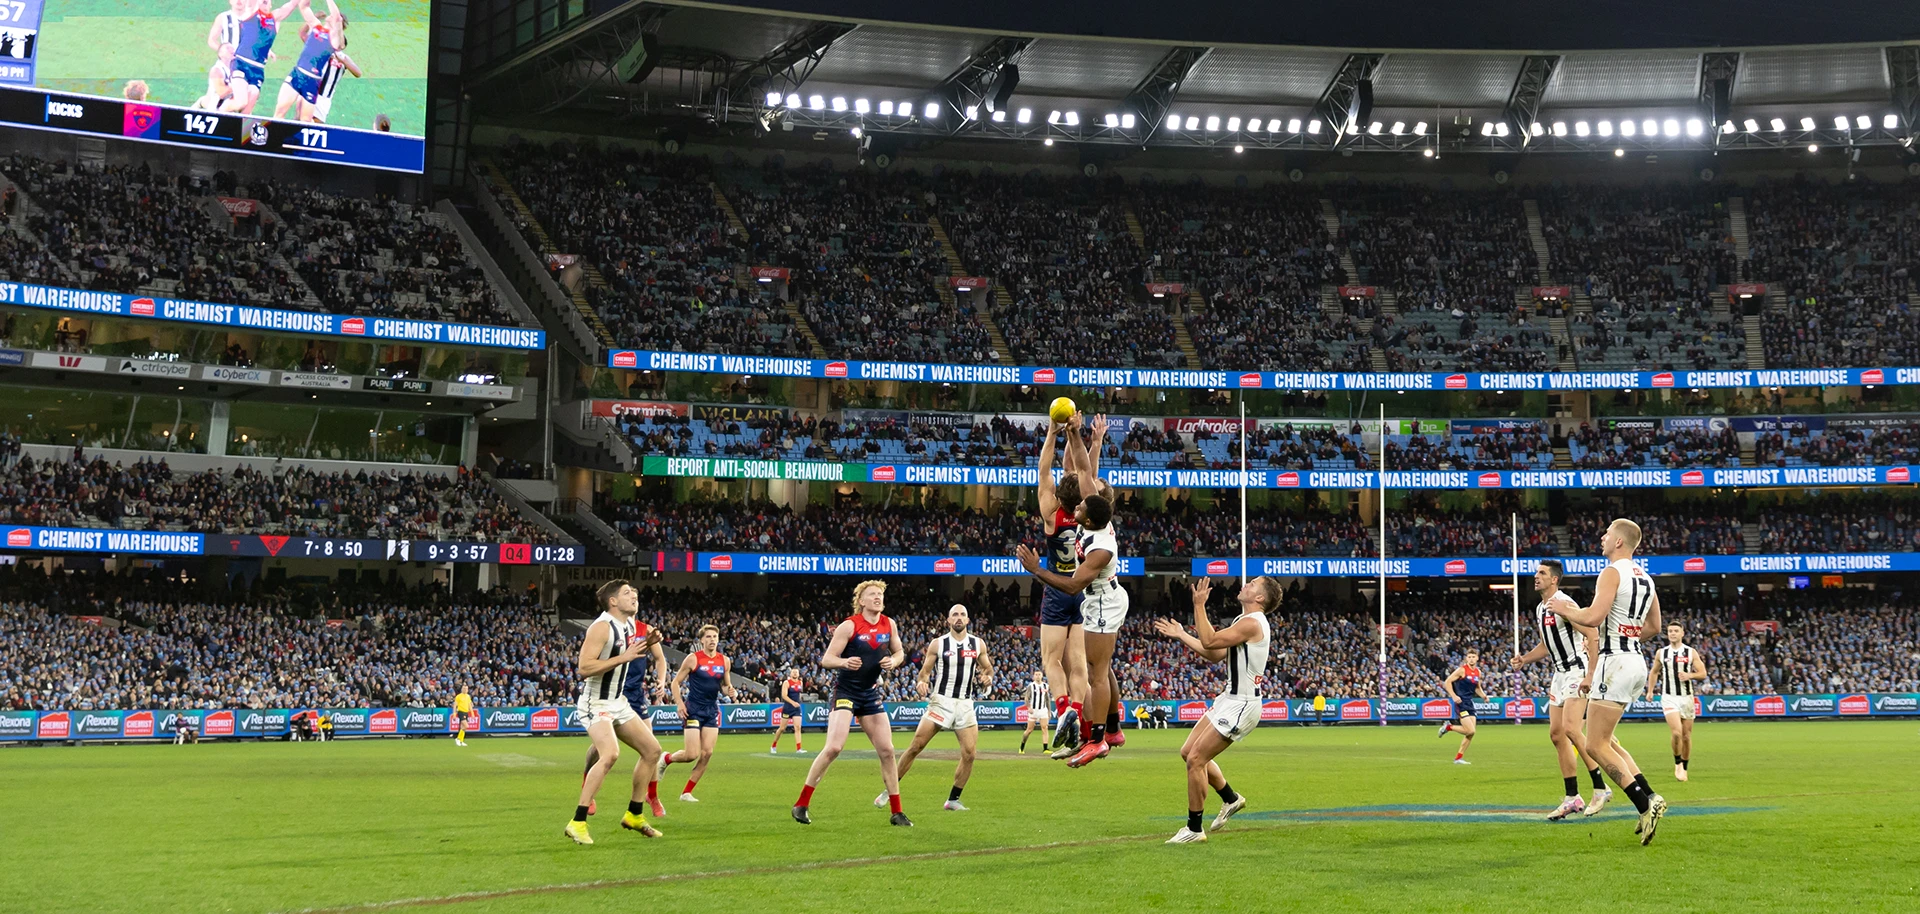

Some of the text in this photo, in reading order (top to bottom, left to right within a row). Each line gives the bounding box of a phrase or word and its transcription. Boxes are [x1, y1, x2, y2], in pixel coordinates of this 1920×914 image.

[11, 68, 24, 78] PM
[47, 102, 83, 118] KICKS
[184, 114, 219, 134] 147
[301, 129, 327, 147] 171
[23, 286, 122, 313] WAREHOUSE
[164, 301, 332, 332] CHEMIST WAREHOUSE
[374, 320, 538, 347] CHEMIST WAREHOUSE
[651, 353, 811, 375] CHEMIST WAREHOUSE
[222, 370, 261, 381] CyberCX
[861, 363, 1020, 382] CHEMIST WAREHOUSE
[1069, 369, 1226, 386] CHEMIST WAREHOUSE
[1687, 370, 1848, 386] CHEMIST WAREHOUSE
[1274, 373, 1432, 388] CHEMIST WAREHOUSE
[1480, 373, 1639, 388] CHEMIST WAREHOUSE
[1670, 419, 1703, 427] CONDOR
[668, 458, 843, 480] REPORT ANTI-SOCIAL BEHAVIOUR
[906, 466, 971, 482] CHEMIST
[1714, 467, 1876, 485] CHEMIST WAREHOUSE
[1108, 471, 1266, 486] CHEMIST WAREHOUSE
[1310, 472, 1468, 487] CHEMIST WAREHOUSE
[1511, 471, 1671, 487] CHEMIST WAREHOUSE
[38, 530, 198, 552] CHEMIST WAREHOUSE
[505, 547, 524, 561] Q4
[535, 547, 575, 562] 01:28
[760, 556, 907, 571] CHEMIST WAREHOUSE
[1264, 560, 1410, 574] CHEMIST WAREHOUSE
[1740, 555, 1891, 571] CHEMIST WAREHOUSE
[583, 568, 637, 580] LANEWAY
[641, 570, 664, 581] BAR
[1628, 577, 1651, 620] 17
[1386, 701, 1416, 711] Rexona
[1716, 699, 1748, 708] Rexona
[1800, 698, 1832, 707] Rexona
[1885, 697, 1917, 706] Rexona
[411, 712, 443, 723] Rexona
[496, 711, 525, 721] Rexona
[736, 708, 766, 717] Rexona
[978, 706, 1009, 715] Rexona
[40, 720, 68, 729] CHEMIST
[86, 715, 118, 727] Rexona
[127, 720, 152, 728] CHEMIST
[207, 720, 233, 728] CHEMIST
[250, 713, 284, 725] Rexona
[334, 713, 364, 724] Rexona
